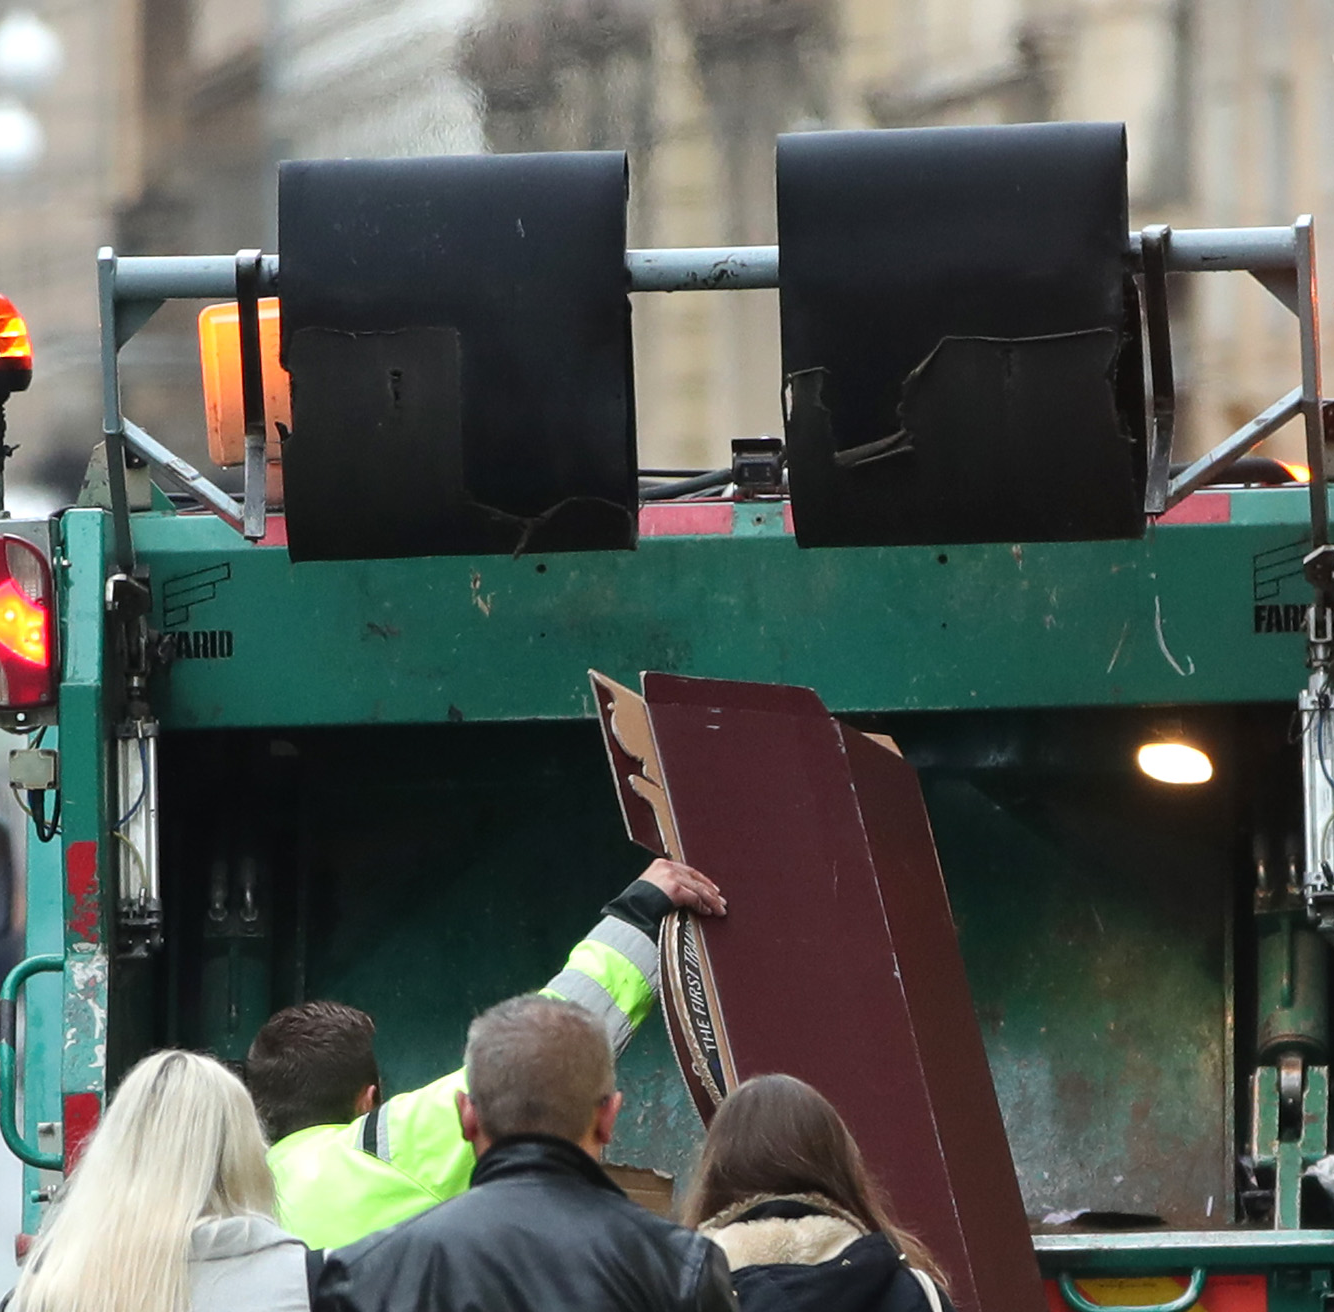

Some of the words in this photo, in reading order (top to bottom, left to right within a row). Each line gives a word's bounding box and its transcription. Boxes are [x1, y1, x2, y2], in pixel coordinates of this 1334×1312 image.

[164, 631, 234, 659] ARID
[684, 964, 708, 1015] FIRST
[696, 1017, 717, 1052] THE
